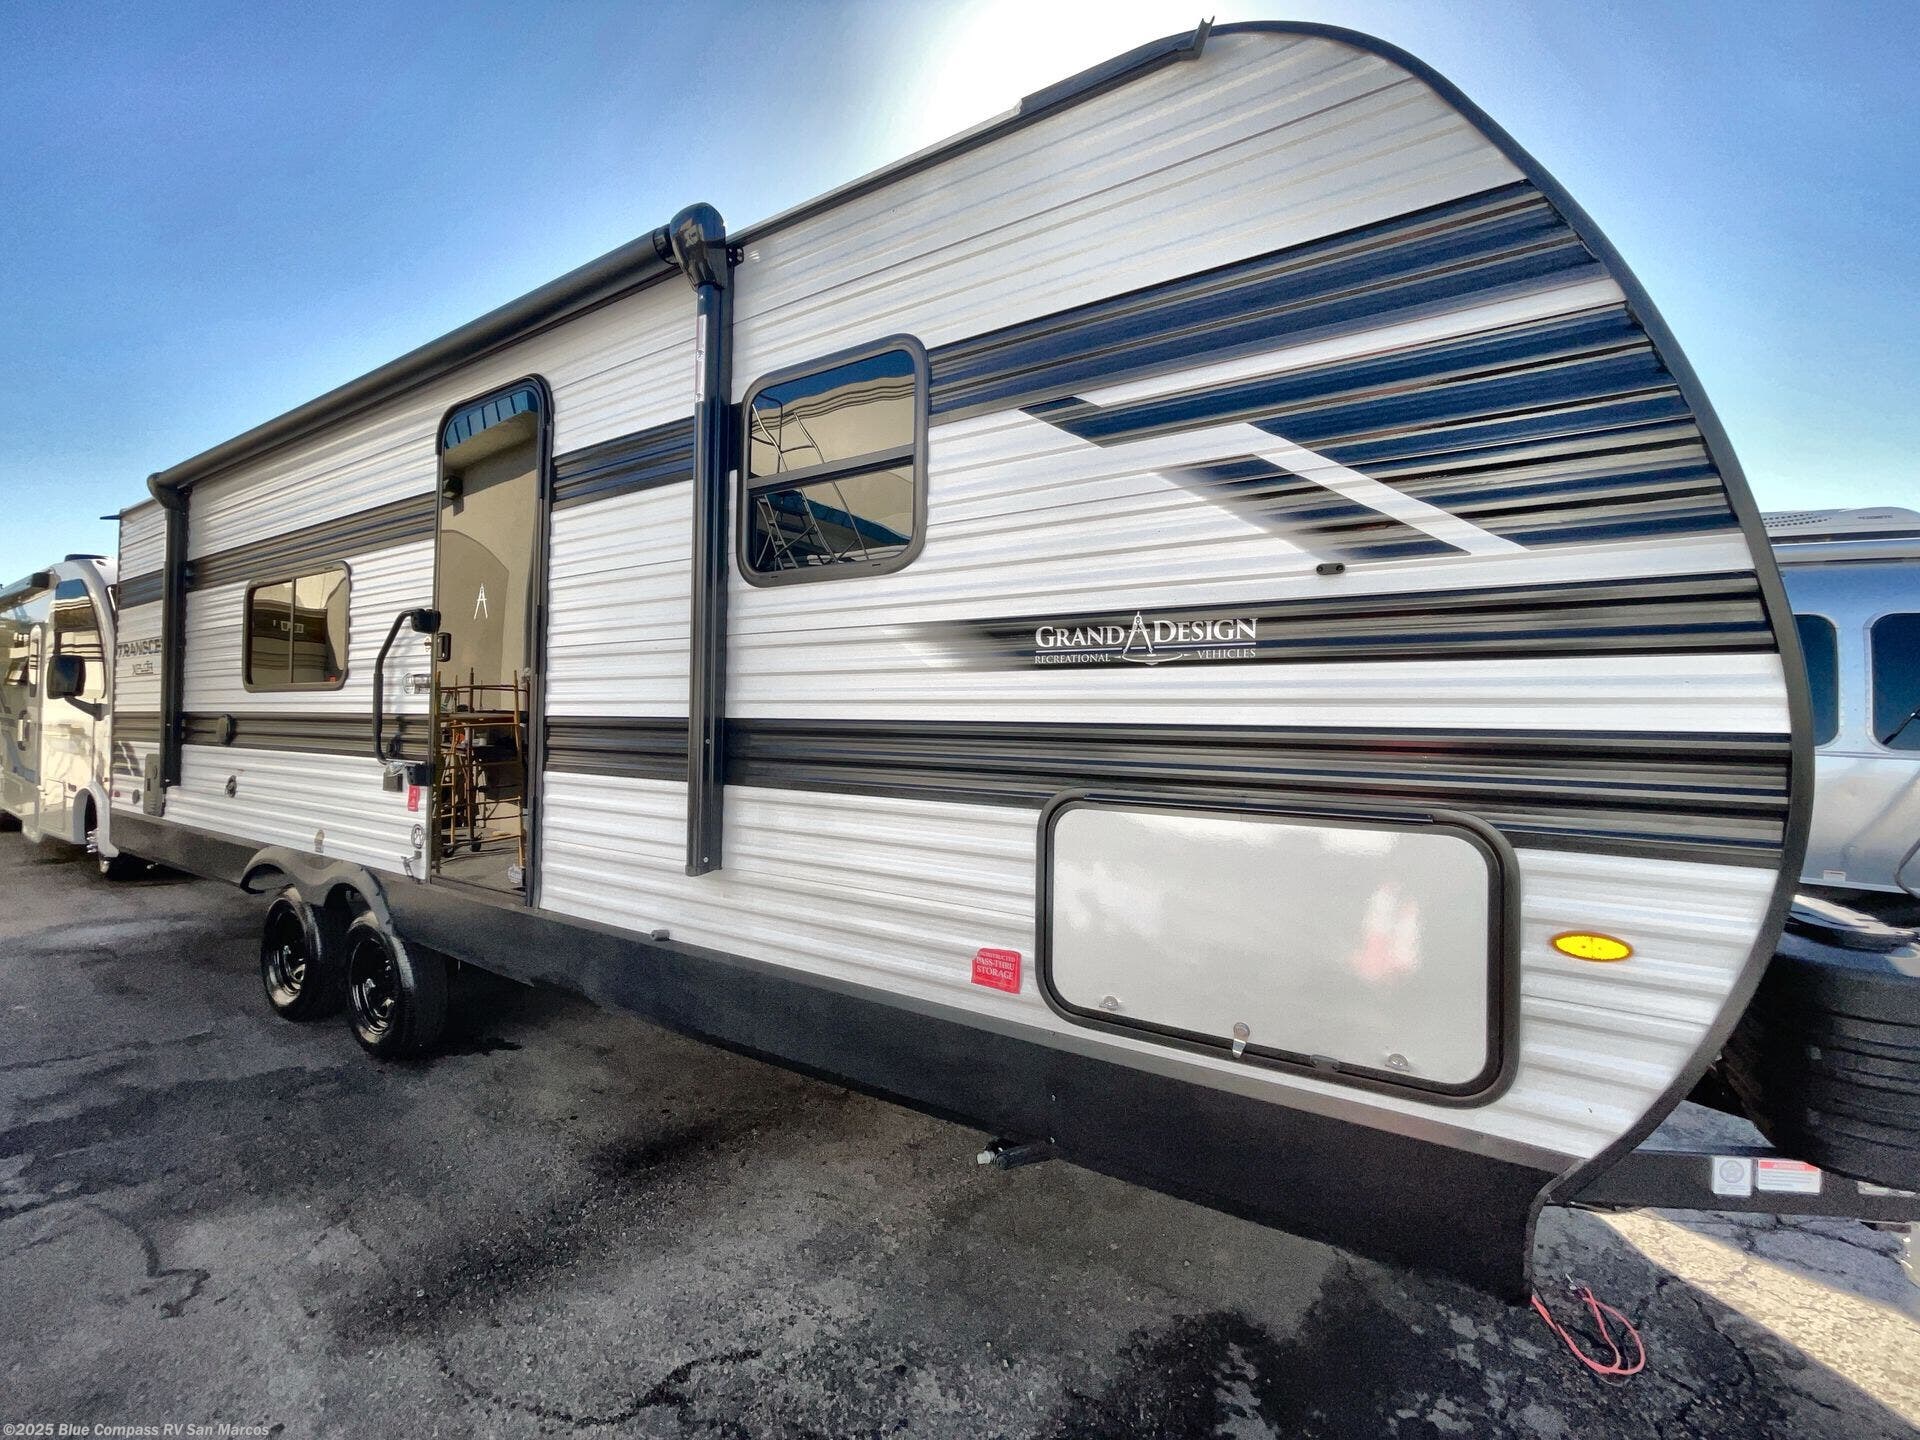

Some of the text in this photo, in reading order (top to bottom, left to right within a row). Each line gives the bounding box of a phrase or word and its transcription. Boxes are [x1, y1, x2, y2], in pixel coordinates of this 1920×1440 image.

[1035, 618, 1259, 648] GRAND DESIGN
[1034, 648, 1257, 664] RECREATIONAL VEHICLES
[976, 965, 1014, 980] STORAGE
